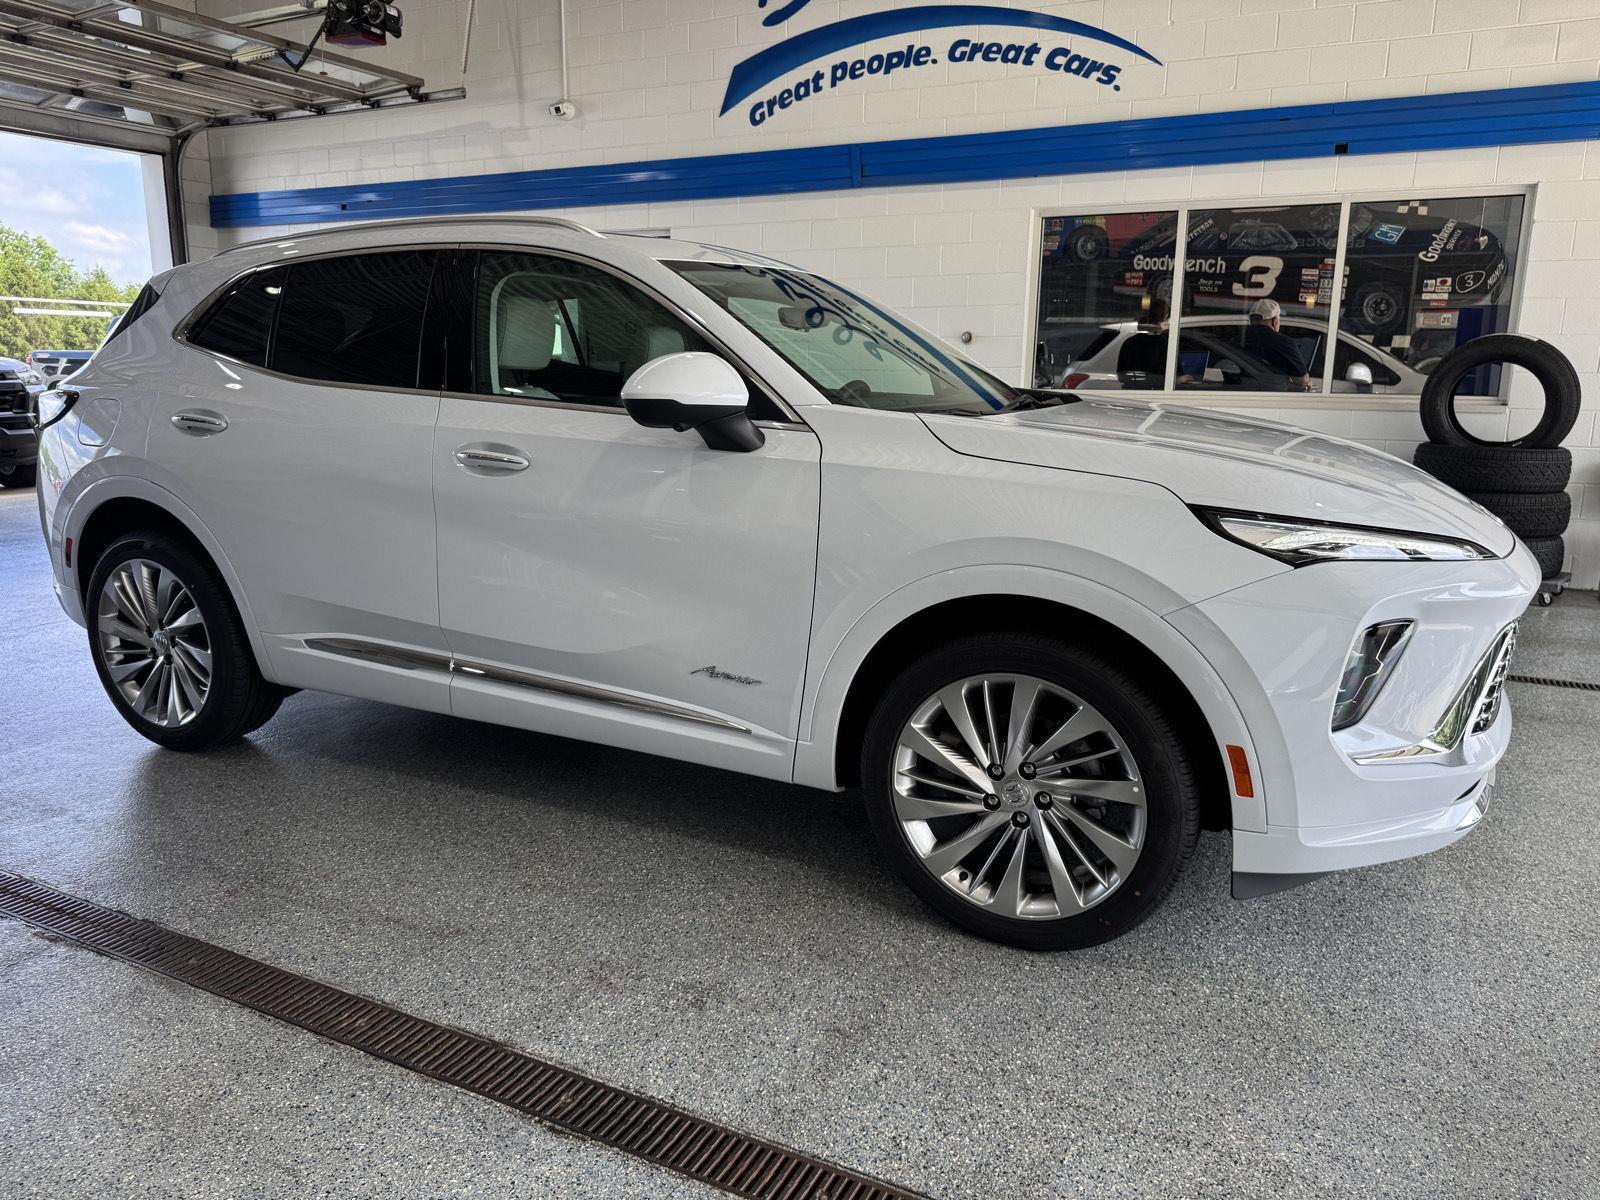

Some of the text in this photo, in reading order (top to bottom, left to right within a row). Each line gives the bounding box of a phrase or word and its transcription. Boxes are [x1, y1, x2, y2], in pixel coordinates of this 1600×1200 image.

[749, 39, 1122, 127] Great people. Great Cars.
[1133, 254, 1226, 273] Goodwench
[1231, 255, 1284, 297] 3
[1464, 273, 1475, 287] 3
